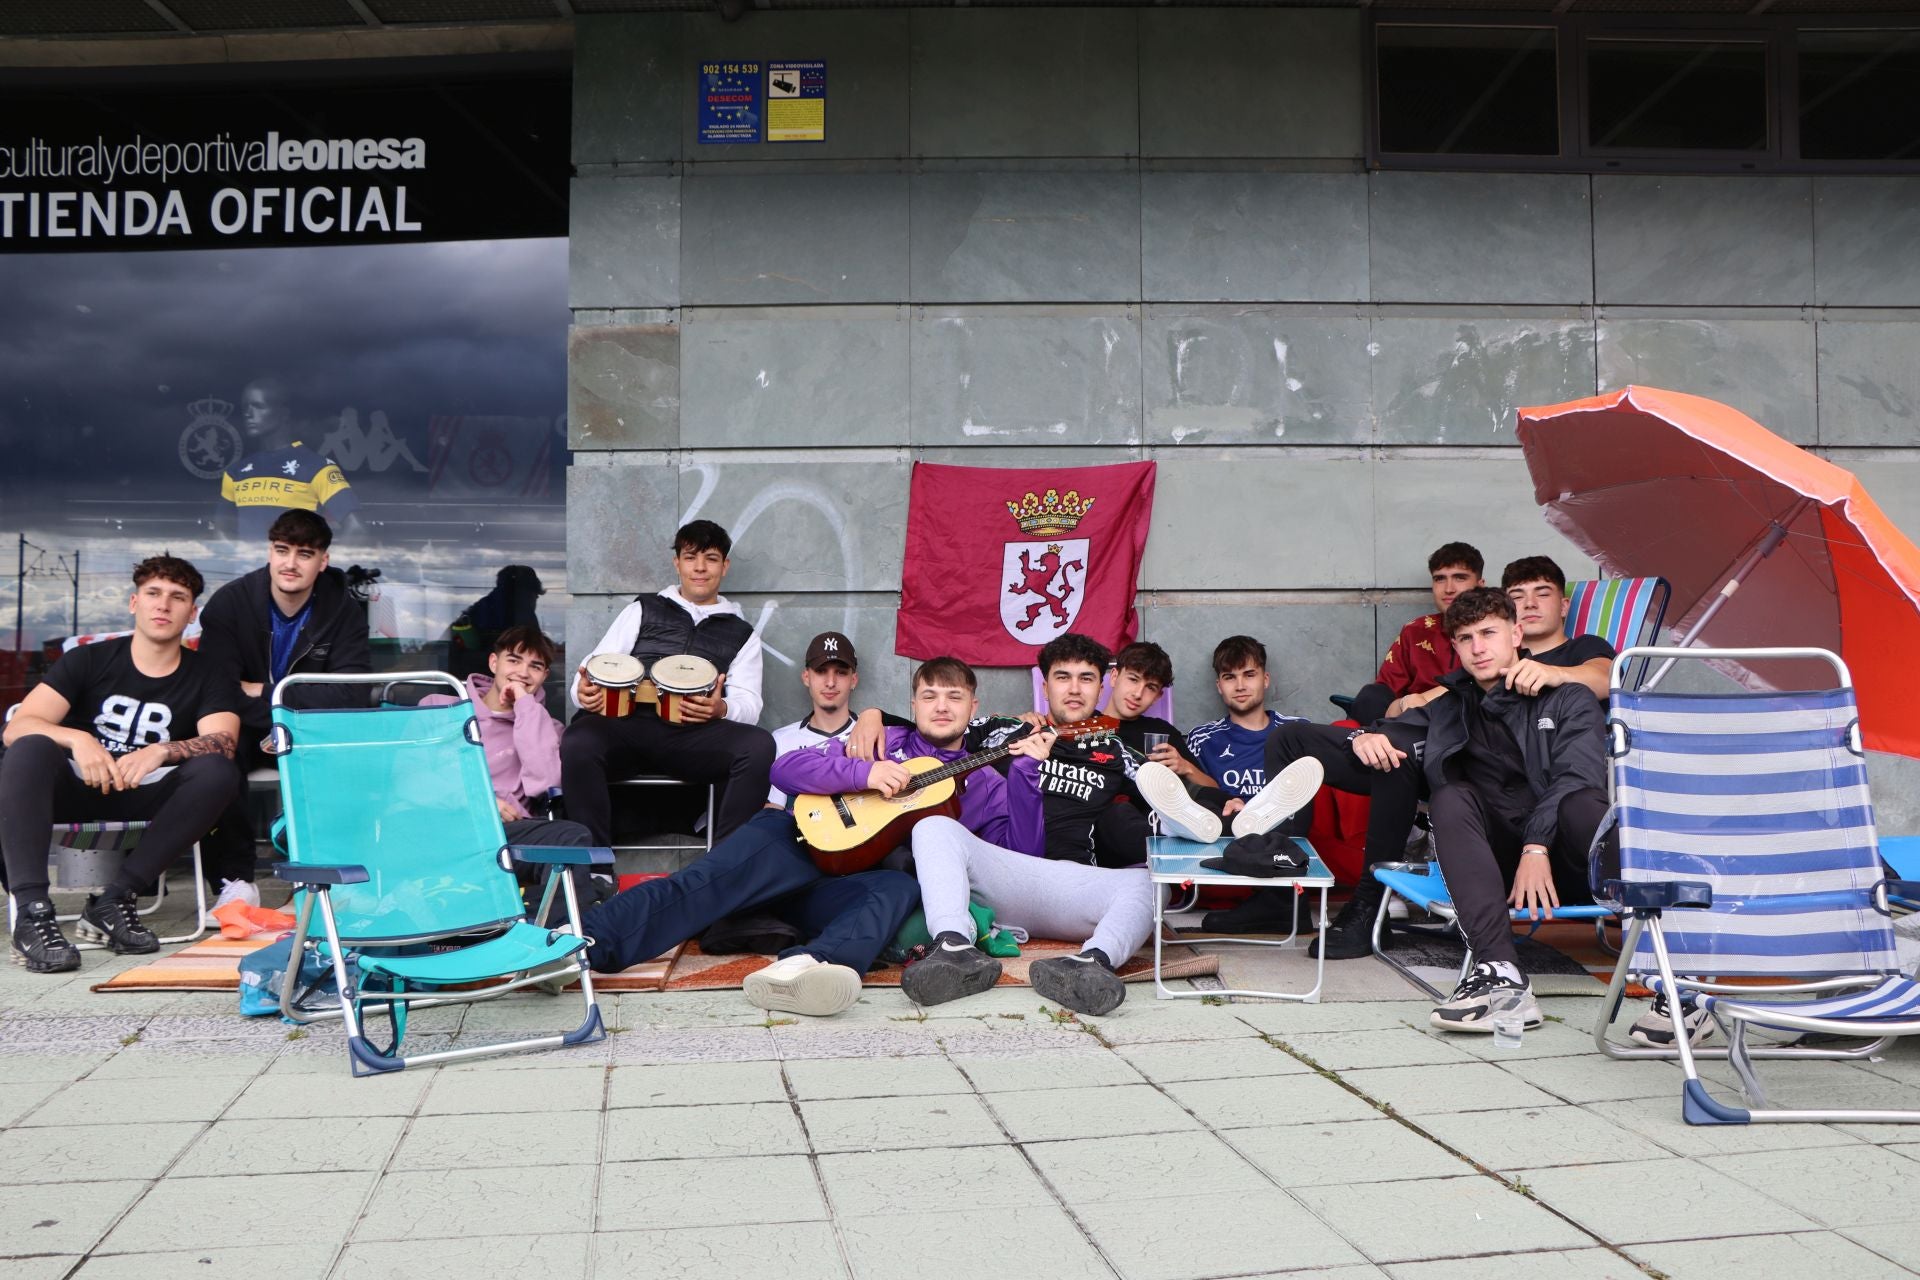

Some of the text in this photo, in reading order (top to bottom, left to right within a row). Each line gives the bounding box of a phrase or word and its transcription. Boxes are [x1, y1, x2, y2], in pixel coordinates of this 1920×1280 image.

[703, 64, 759, 74] 902 154 539
[0, 186, 422, 238] TIENDA OFICIAL
[1047, 776, 1093, 801] BETTER
